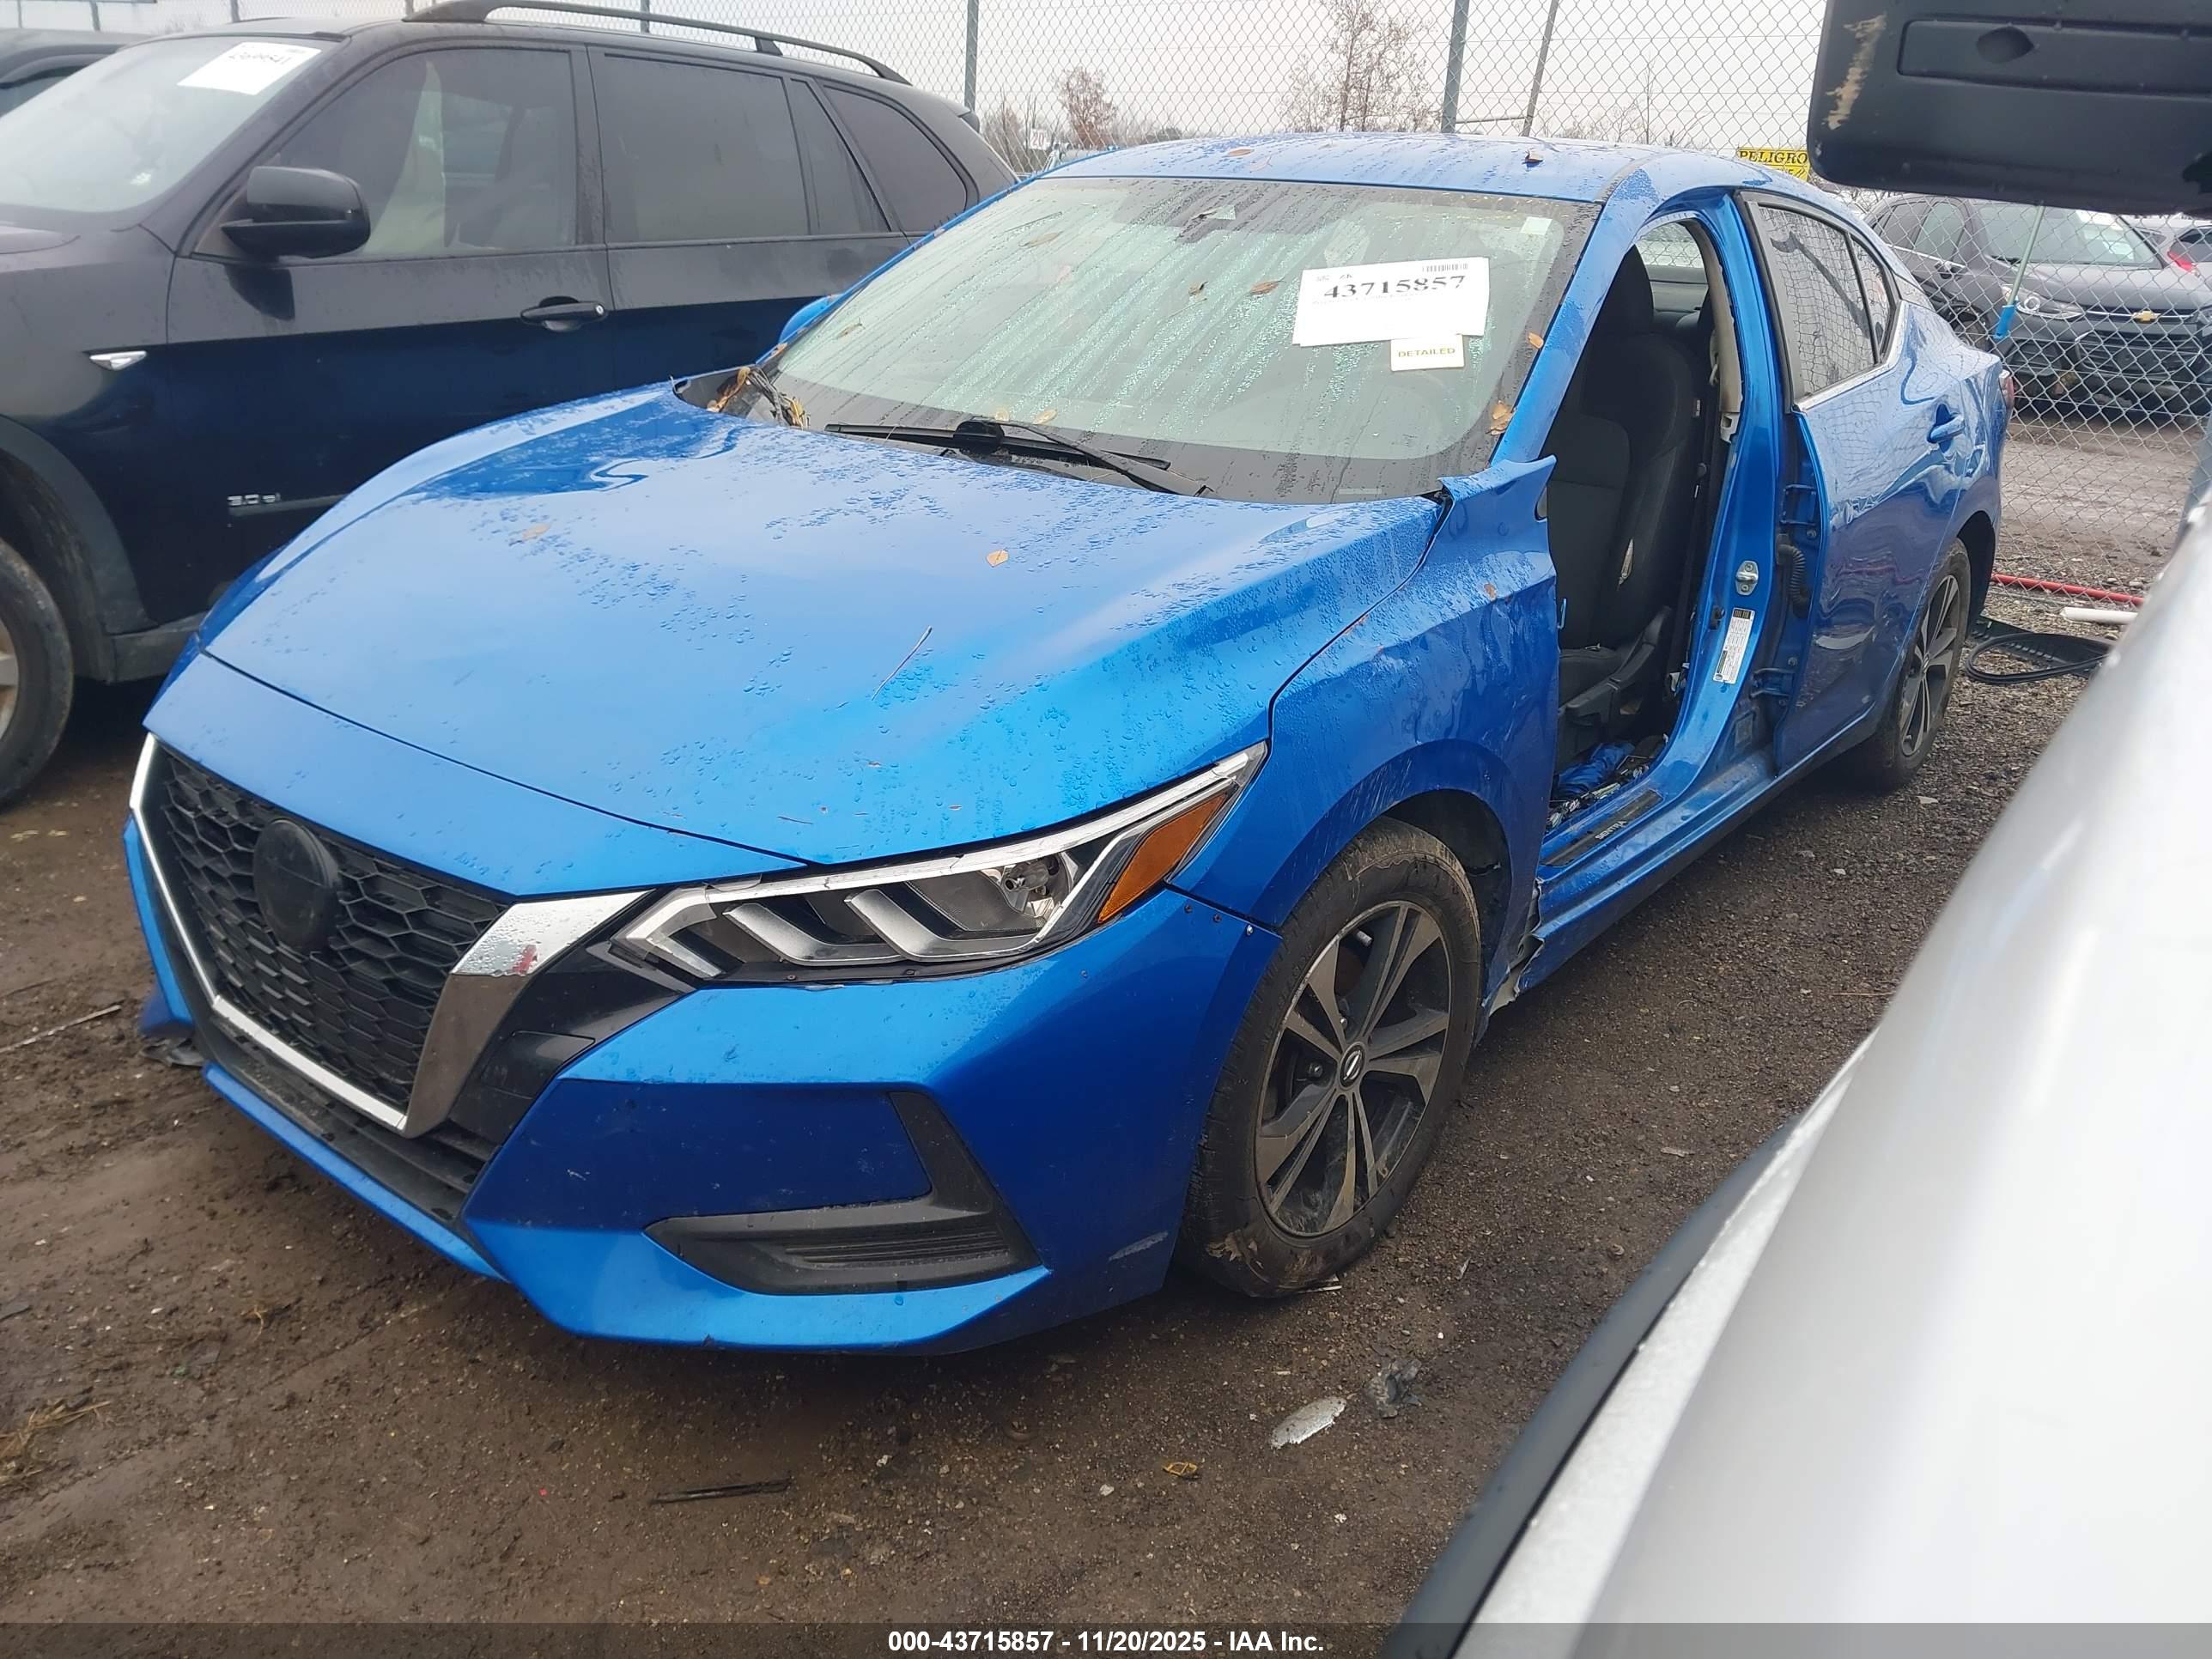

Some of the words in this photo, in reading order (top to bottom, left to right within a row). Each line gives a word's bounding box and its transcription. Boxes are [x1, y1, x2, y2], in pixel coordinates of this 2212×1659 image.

[1740, 150, 1808, 164] PELIGRO
[1324, 275, 1466, 298] 43715857
[1398, 347, 1456, 358] DETAILED
[1595, 820, 1627, 840] SENTRA
